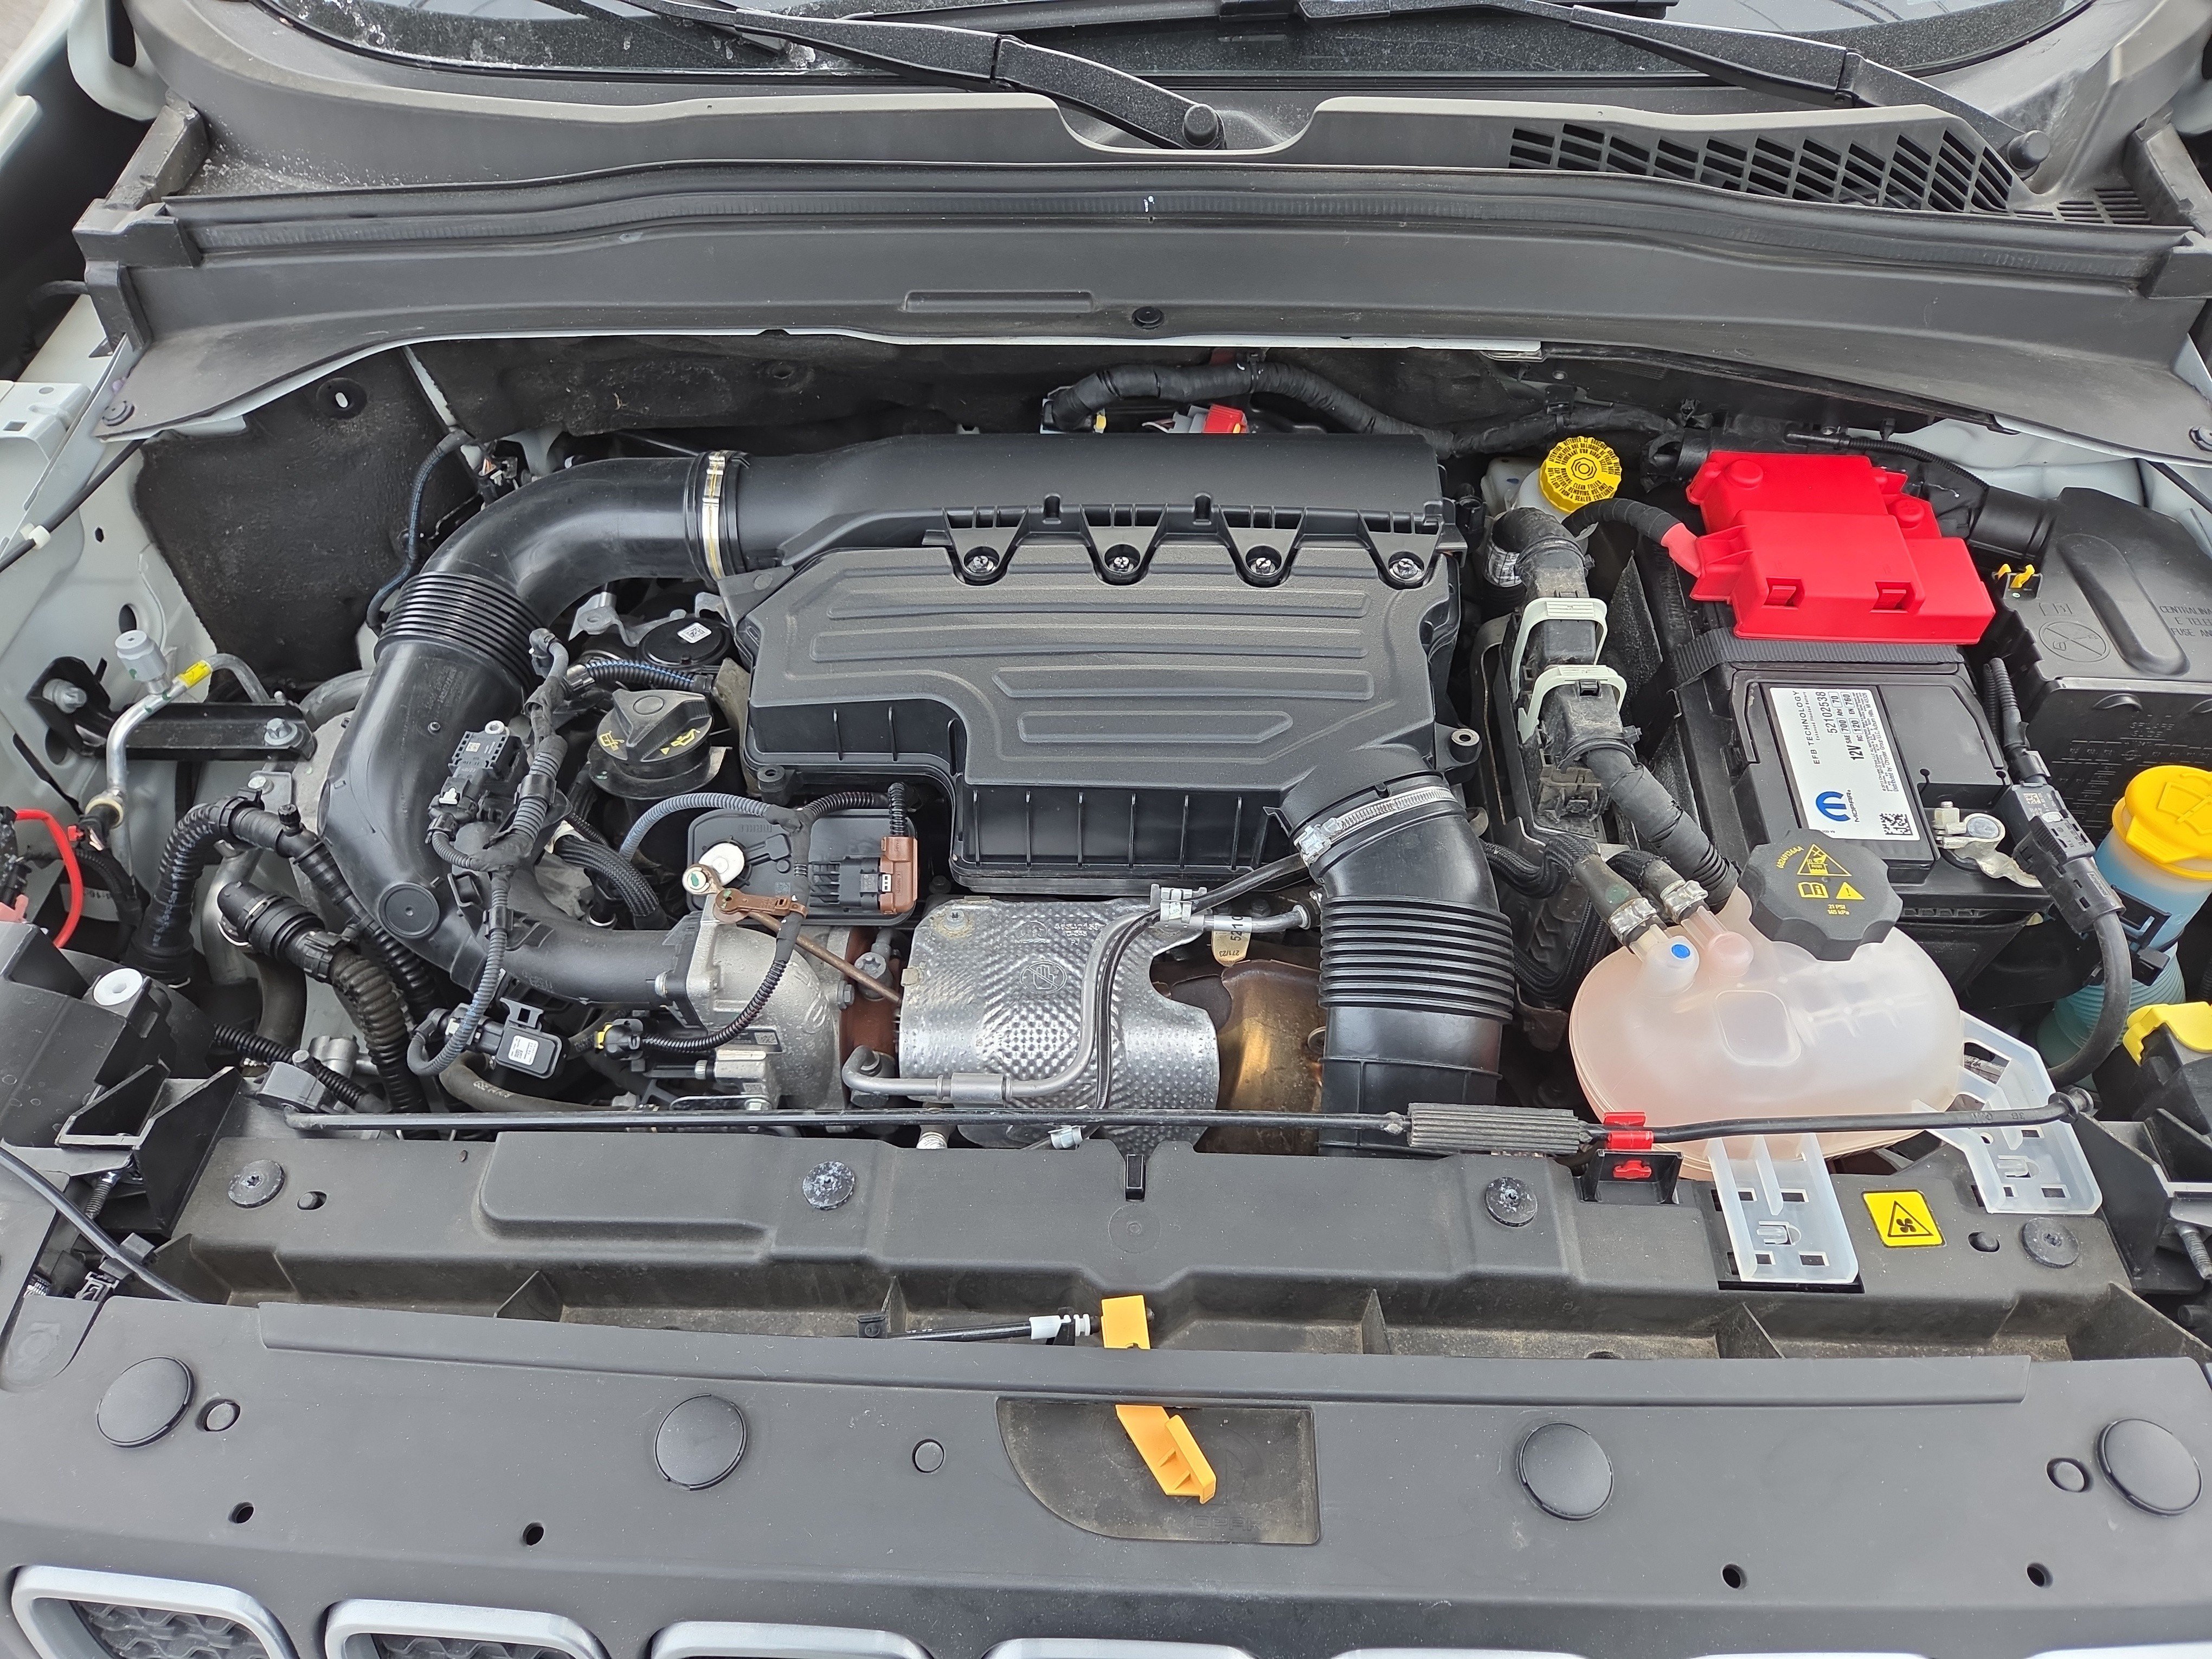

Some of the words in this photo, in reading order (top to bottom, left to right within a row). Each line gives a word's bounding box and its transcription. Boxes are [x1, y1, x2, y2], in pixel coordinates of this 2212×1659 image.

[1559, 487, 1570, 497] FROM
[1843, 694, 1853, 705] 760
[1792, 691, 1815, 746] TECHNOLOGY
[1816, 692, 1838, 734] 52102538
[1839, 720, 1849, 731] 700
[1851, 720, 1861, 732] 120
[1811, 749, 1820, 764] EFB
[1847, 745, 1864, 761] 12V
